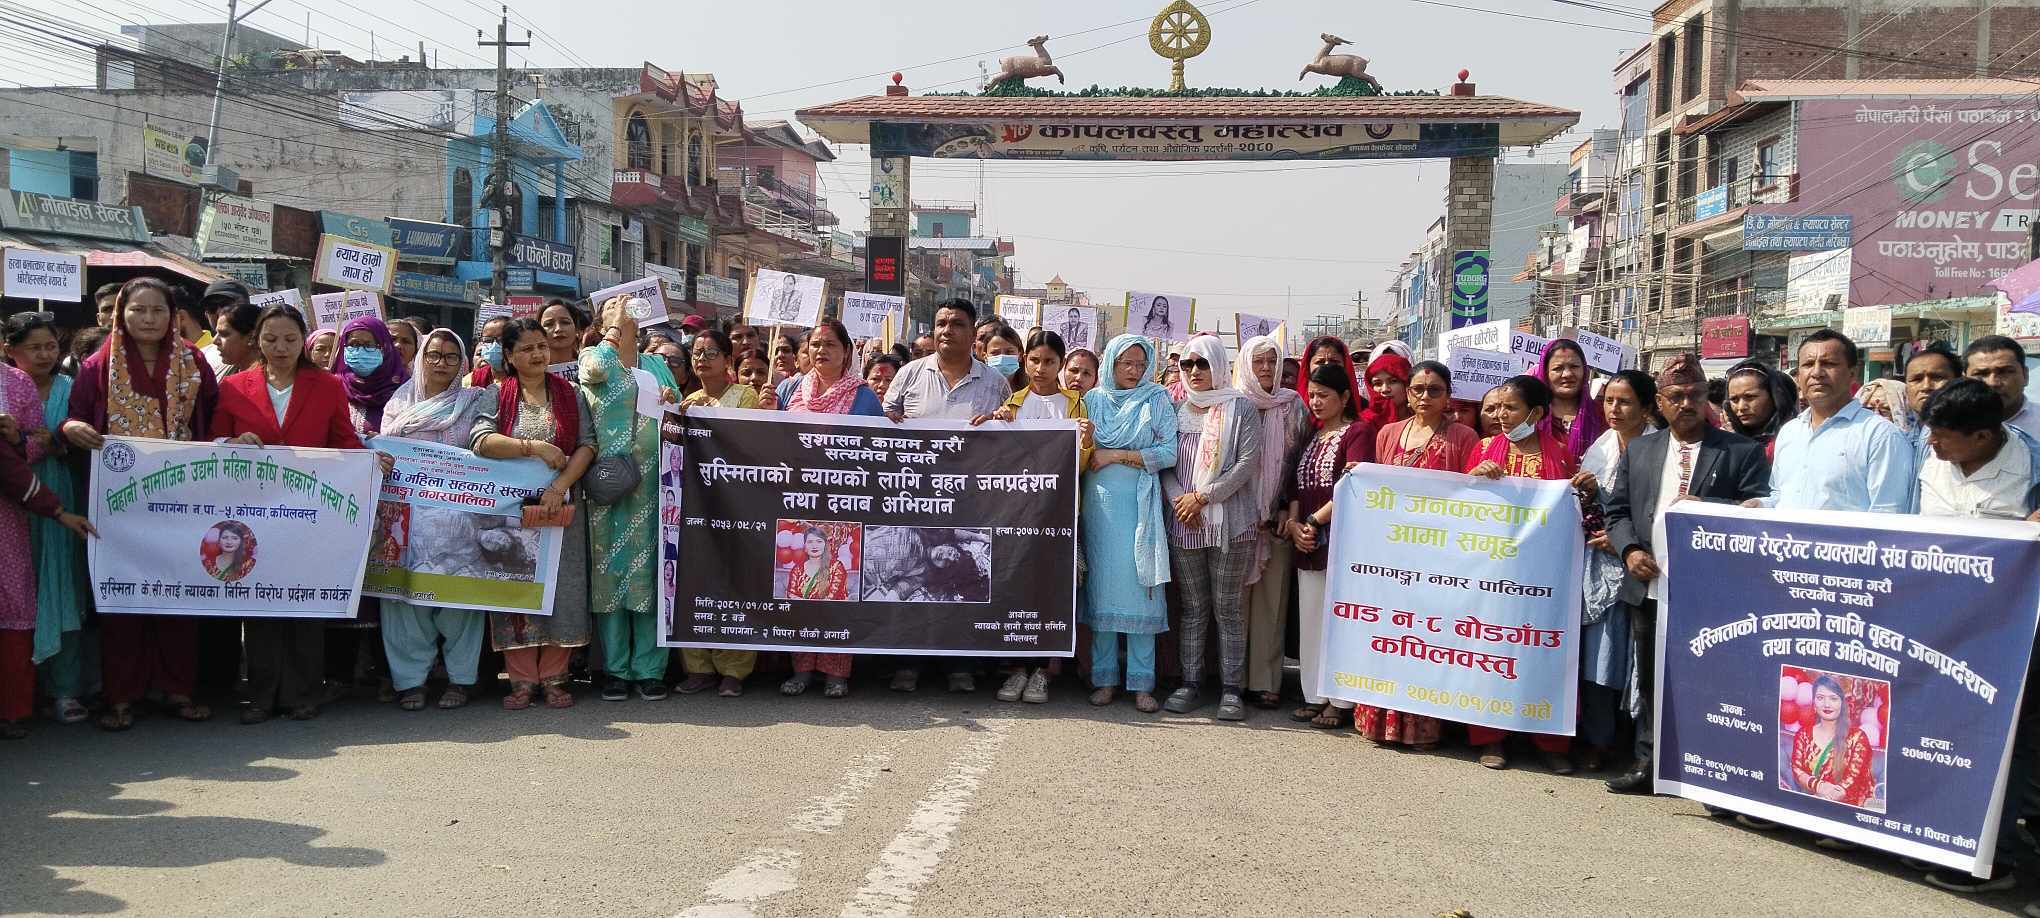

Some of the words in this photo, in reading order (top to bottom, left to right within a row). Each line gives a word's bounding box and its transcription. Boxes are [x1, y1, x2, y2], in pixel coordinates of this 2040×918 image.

[1966, 139, 2040, 200] Se
[95, 201, 133, 226] सेन्टर
[1894, 210, 1992, 229] MONEY
[406, 230, 444, 248] LUMINOUS
[336, 246, 359, 264] न्याय
[361, 250, 382, 267] हाम्रो
[552, 252, 574, 272] हाउस
[342, 266, 361, 282] माग
[361, 268, 374, 284] हो
[1455, 273, 1488, 283] TUBORG
[1934, 266, 1950, 278] Toll
[1951, 267, 1968, 278] Free
[1474, 326, 1499, 346] छोरीले
[798, 432, 864, 449] सुशासन
[871, 436, 923, 450] कायम
[825, 448, 889, 462] सत्यमेव
[896, 450, 940, 465] जयते
[142, 459, 187, 501] सामाजिक
[190, 451, 219, 482] उद्यमी
[223, 450, 252, 483] महिला
[256, 455, 279, 491] कृषि
[282, 466, 318, 500] सहकारी
[320, 480, 345, 513] संस्था
[405, 472, 445, 488] महिला
[448, 479, 496, 495] सहकारी
[698, 456, 794, 488] सुस्मिताको
[800, 465, 870, 488] न्यायको
[877, 466, 924, 490] लागि
[931, 473, 969, 497] वृहत
[419, 488, 497, 508] नगरपालिका
[782, 490, 820, 511] तथा
[827, 493, 874, 514] दवाब
[882, 490, 956, 515] अभियान
[1365, 485, 1397, 512] श्री
[1403, 495, 1551, 527] जनकल्याण
[685, 517, 708, 527] जन्म:
[711, 519, 767, 532] २०५३/०९/२१
[1385, 522, 1448, 548] आमा
[1455, 531, 1521, 561] समूह
[1691, 525, 1727, 551] होटल
[1729, 534, 1757, 554] तथा
[1814, 540, 1878, 566] व्यवसायी
[1880, 544, 1909, 569] संघ
[1910, 544, 1995, 584] कपिलवस्तु
[99, 577, 137, 600] सुस्मिता
[224, 581, 250, 600] निम्ति
[254, 581, 283, 602] विरोध
[1428, 572, 1472, 590] नगर
[1479, 579, 1554, 598] पालिका
[1771, 569, 1820, 586] सुशासन
[1822, 574, 1863, 592] कायम
[778, 602, 792, 612] गते
[1788, 586, 1836, 603] सत्यमेव
[1839, 592, 1874, 608] जयते
[1008, 610, 1041, 619] आयोजक
[1333, 600, 1383, 624] वाड
[1454, 616, 1567, 649] बोडगाँउ
[693, 625, 717, 635] स्थान:
[763, 628, 769, 639] २
[773, 626, 796, 639] पिपरा
[799, 627, 821, 640] चौकी
[823, 627, 850, 640] अगाडी
[974, 620, 1002, 630] न्यायको
[1044, 620, 1068, 632] समिति
[1689, 613, 1759, 657] सुस्मिताको
[1761, 607, 1823, 632] न्यायको
[1825, 612, 1866, 639] लागि
[1868, 622, 1905, 652] वृहत
[1003, 632, 1039, 645] कपिलवस्तु
[1370, 635, 1518, 680] कपिलवस्तु
[1762, 637, 1793, 658] तथा
[1794, 637, 1832, 658] दवाब
[1834, 639, 1901, 677] अभियान
[1333, 671, 1397, 696] स्थापना
[1520, 700, 1553, 722] गते
[1719, 702, 1747, 717] जन्म:
[1705, 712, 1763, 734] २०५३/०९/२१
[1919, 736, 1955, 752] हत्या:
[1684, 752, 1704, 765] मिति:
[1750, 770, 1765, 782] गते
[1901, 746, 1973, 769] २०७७/०३/०२
[1855, 812, 1883, 826] स्थान:
[1915, 827, 1922, 837] २
[1923, 825, 1950, 843] पिपरा
[1951, 834, 1977, 851] चौकी
